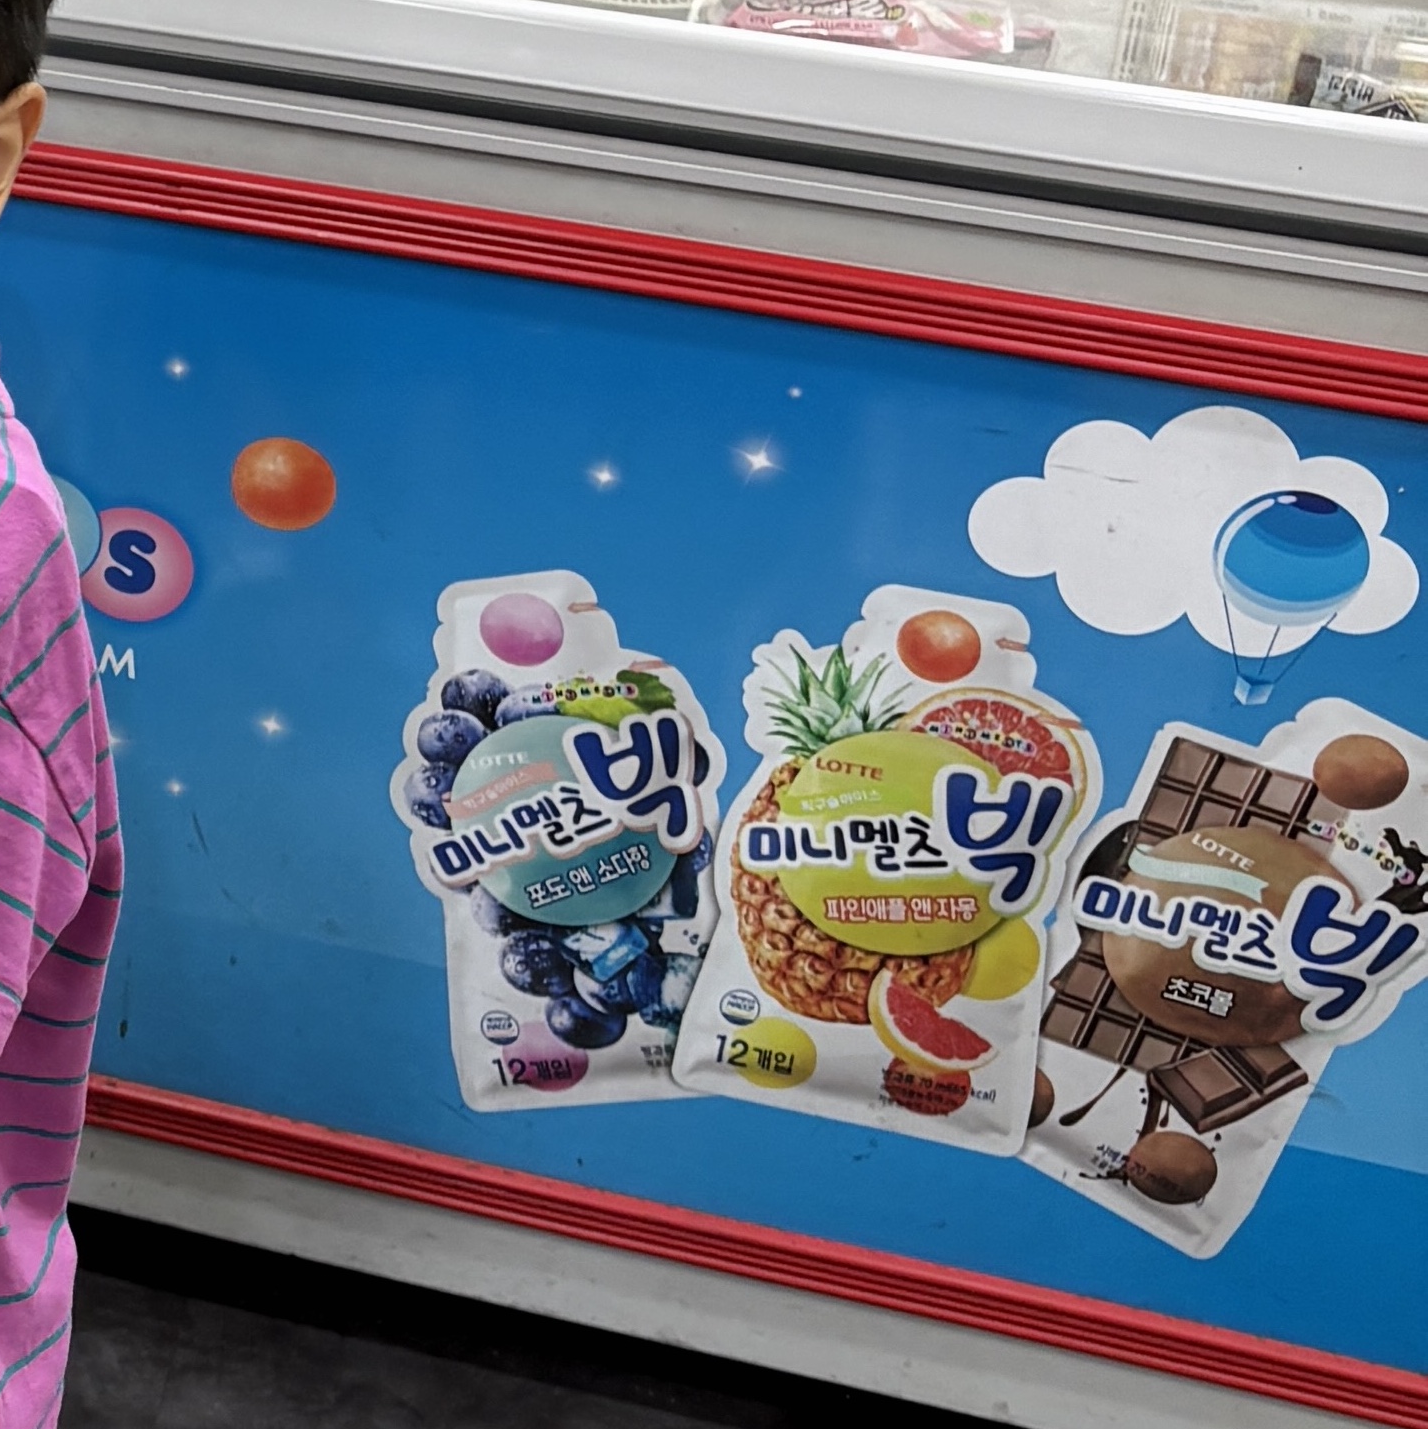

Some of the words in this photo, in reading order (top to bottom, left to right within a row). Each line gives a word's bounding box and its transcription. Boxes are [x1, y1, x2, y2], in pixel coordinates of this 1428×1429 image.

[469, 752, 530, 771] LOTTE
[816, 757, 883, 781] LOTTE
[433, 787, 612, 876] 미니멜츠
[572, 717, 688, 838] 빅
[748, 816, 948, 872] 미니멜츠
[946, 772, 1063, 903] 빅
[1191, 833, 1255, 872] LOTTE
[527, 875, 572, 909] 포도
[570, 869, 593, 893] 앤
[598, 843, 652, 883] 소다향
[825, 897, 907, 921] 파인애플
[911, 897, 931, 920] 앤
[938, 897, 978, 921] 자몽
[1082, 881, 1278, 970] 미니멜츠
[1291, 885, 1420, 1021] 빅
[1163, 977, 1234, 1017] 초코볼
[492, 1057, 574, 1087] 12개입
[716, 1034, 795, 1076] 12개입
